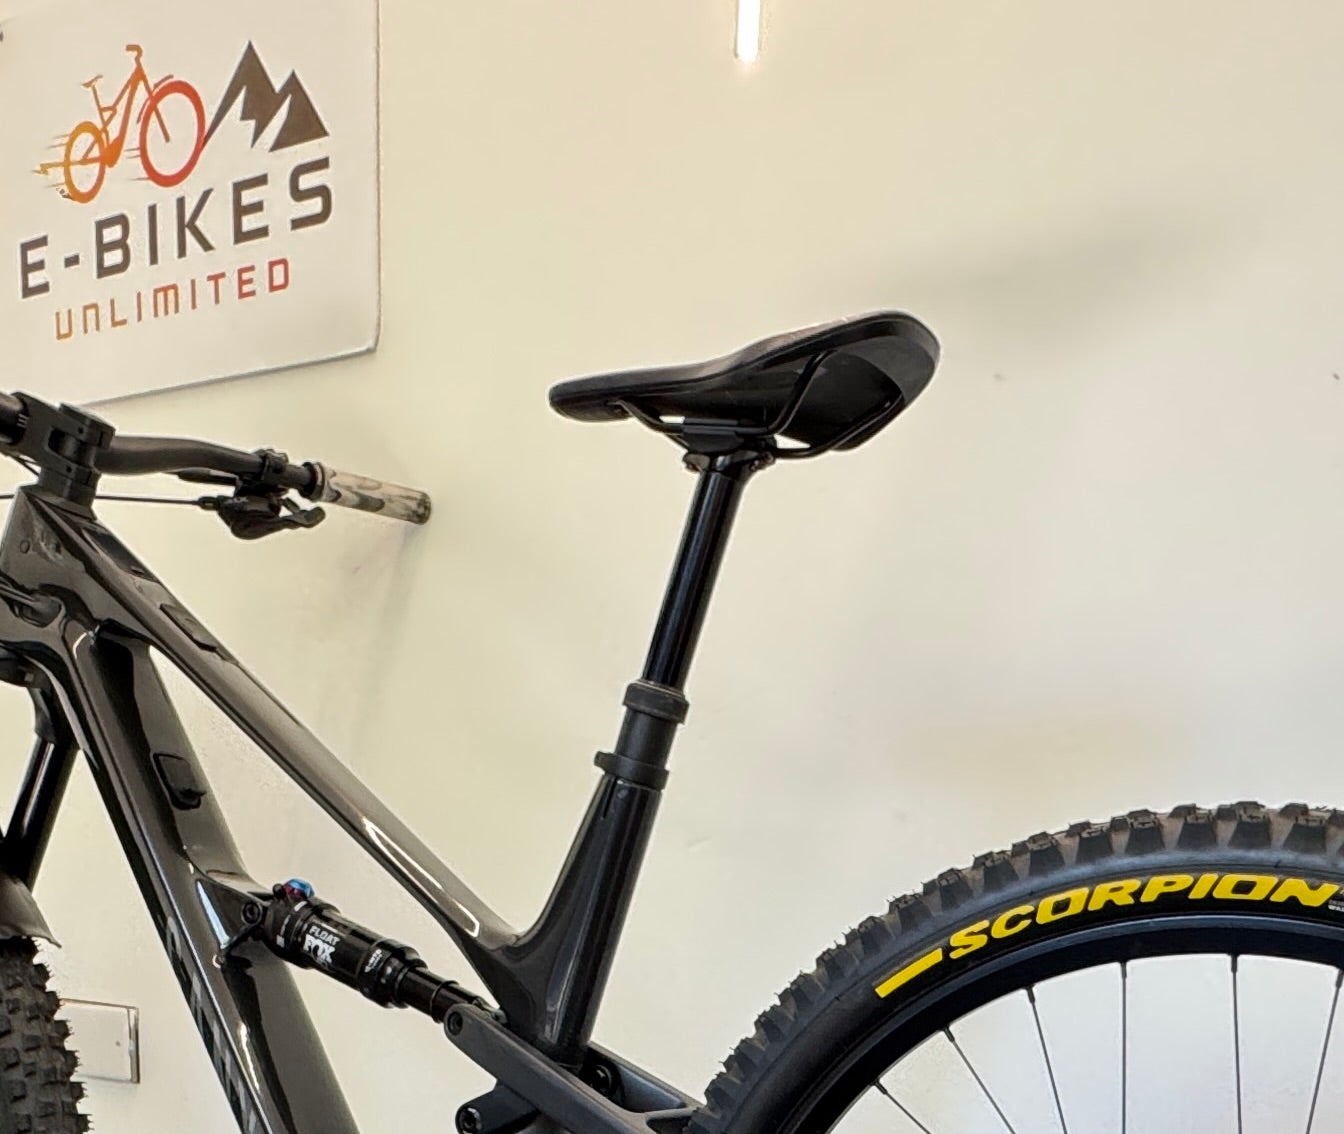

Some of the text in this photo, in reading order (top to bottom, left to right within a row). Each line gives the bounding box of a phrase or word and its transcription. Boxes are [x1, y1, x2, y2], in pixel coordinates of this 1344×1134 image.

[19, 155, 333, 299] E-BIKES
[55, 257, 291, 341] UNLIMITED
[302, 934, 337, 964] FOX
[309, 925, 341, 947] FLOAT
[949, 872, 1340, 960] SCORPION
